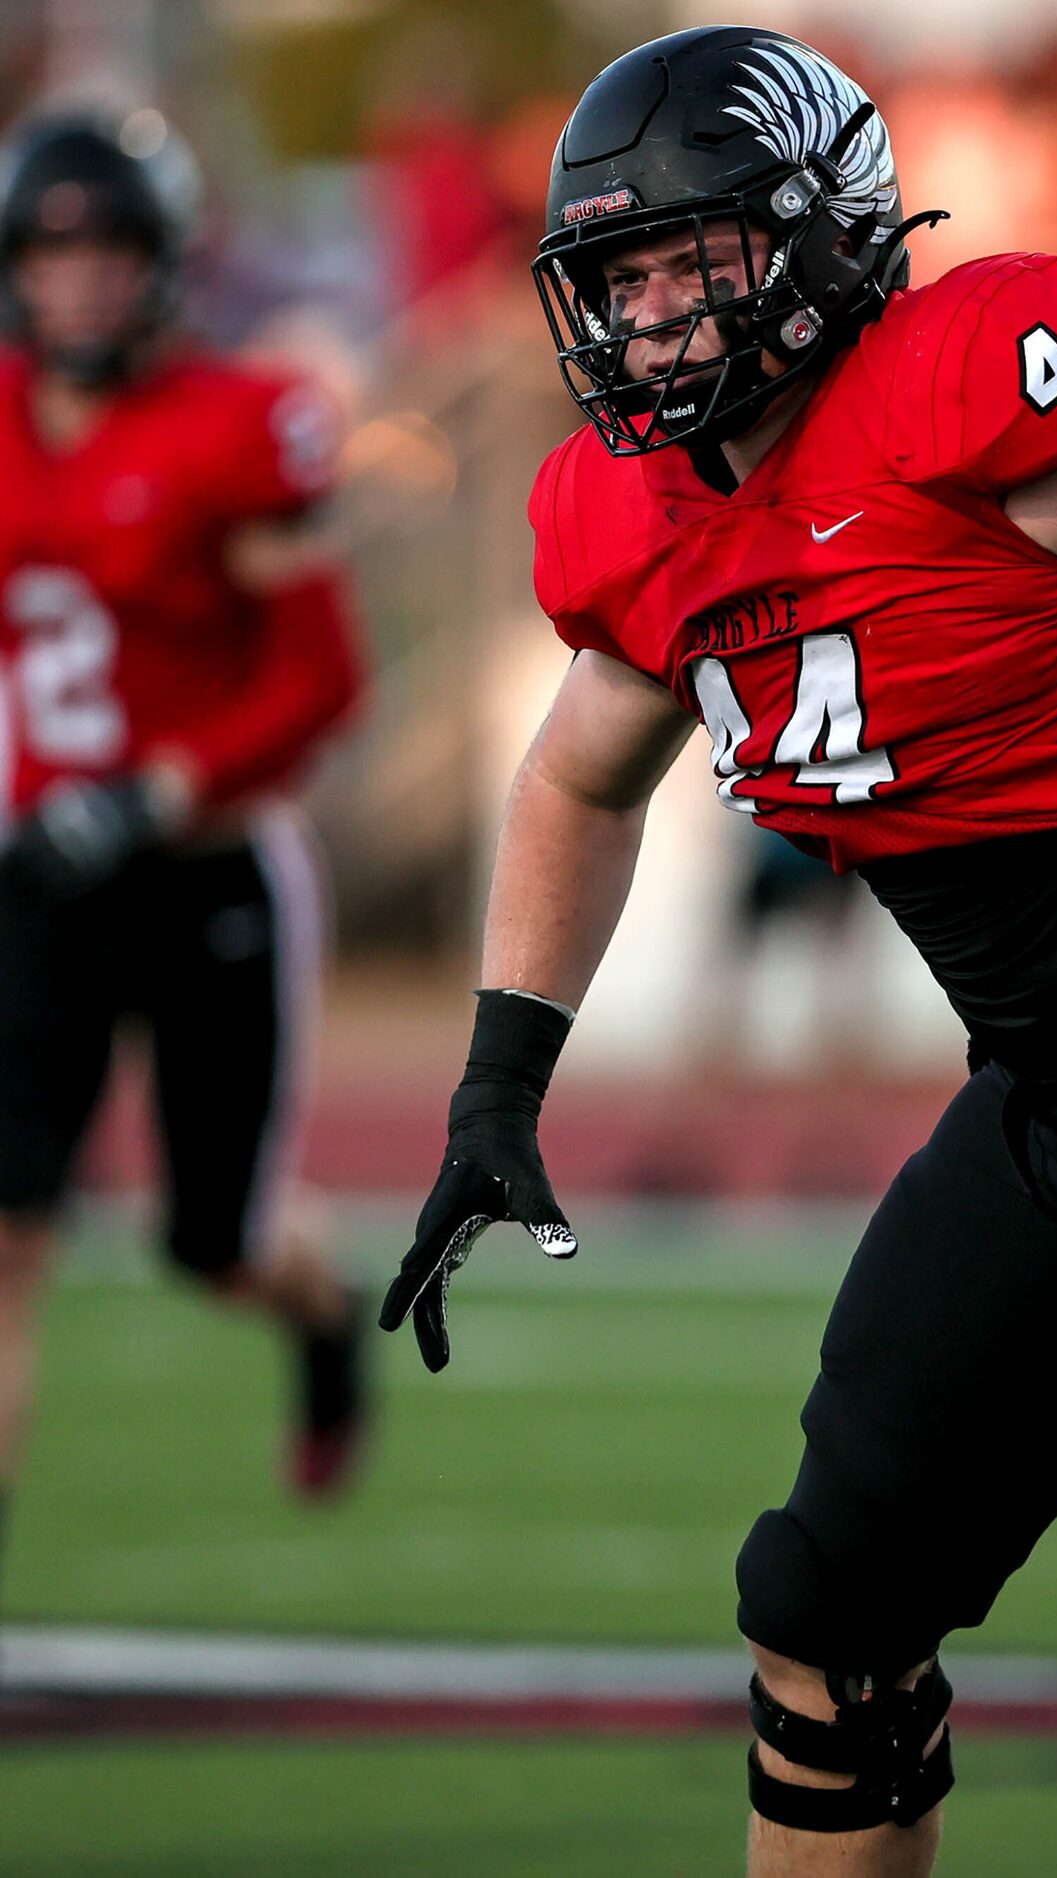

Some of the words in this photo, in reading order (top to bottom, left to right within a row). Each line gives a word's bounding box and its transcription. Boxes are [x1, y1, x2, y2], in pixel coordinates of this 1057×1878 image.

[564, 189, 630, 225] ARGYLE
[662, 403, 696, 421] Riddell
[684, 628, 900, 815] 44
